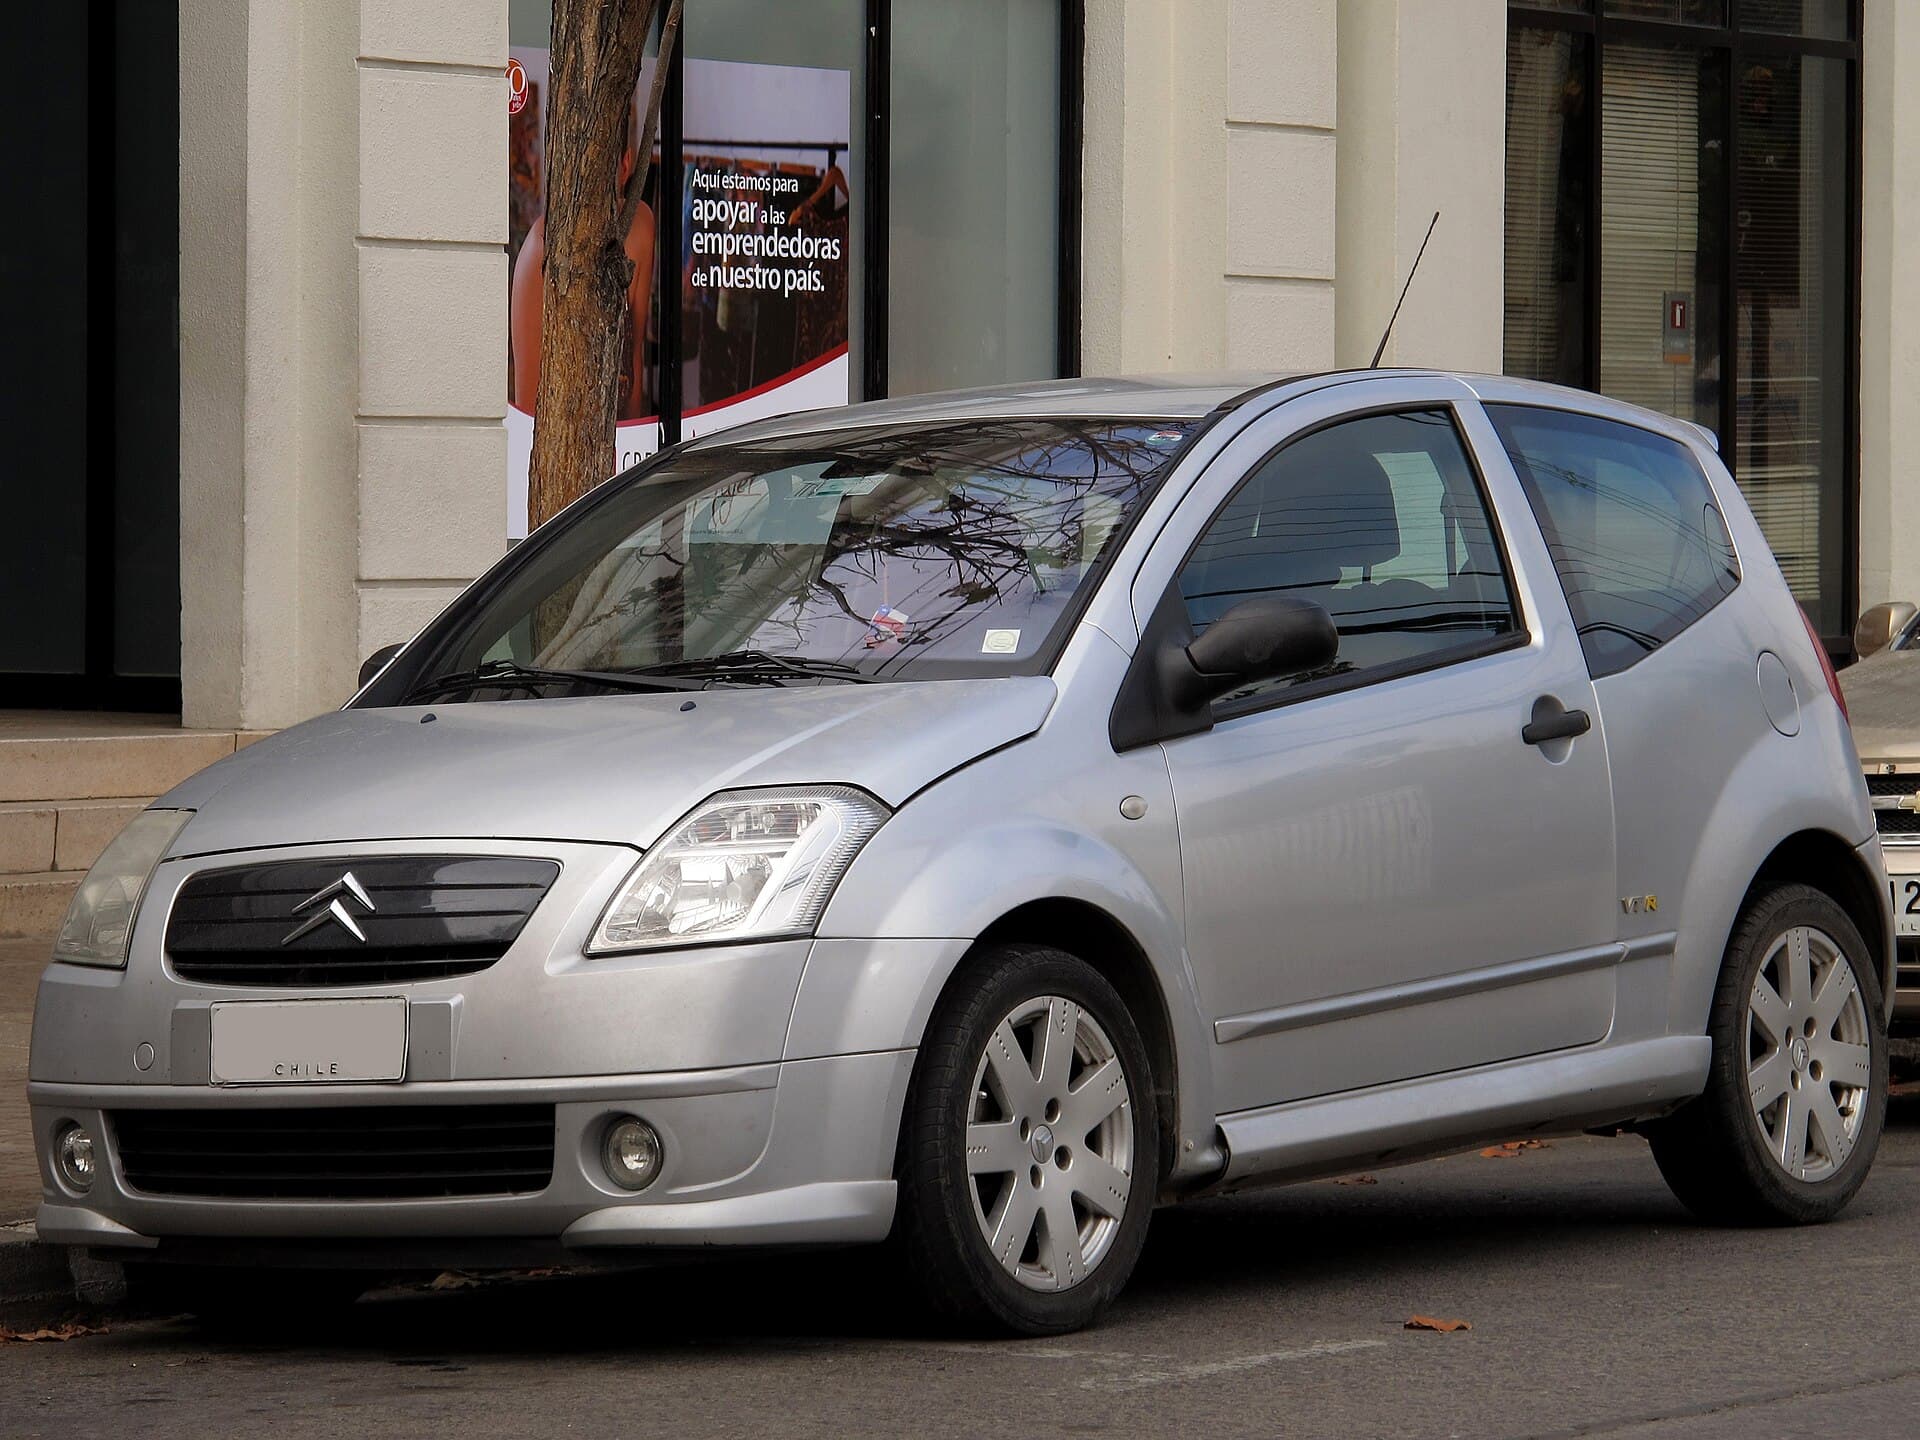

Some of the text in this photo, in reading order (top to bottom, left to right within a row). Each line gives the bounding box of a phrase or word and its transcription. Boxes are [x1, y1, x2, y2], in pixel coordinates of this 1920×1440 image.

[692, 169, 799, 197] Aquí estamos para
[692, 198, 786, 230] apoyar a las
[692, 227, 841, 262] emprendedoras
[691, 262, 825, 298] de nuestro país.
[274, 1063, 338, 1076] CHILE
